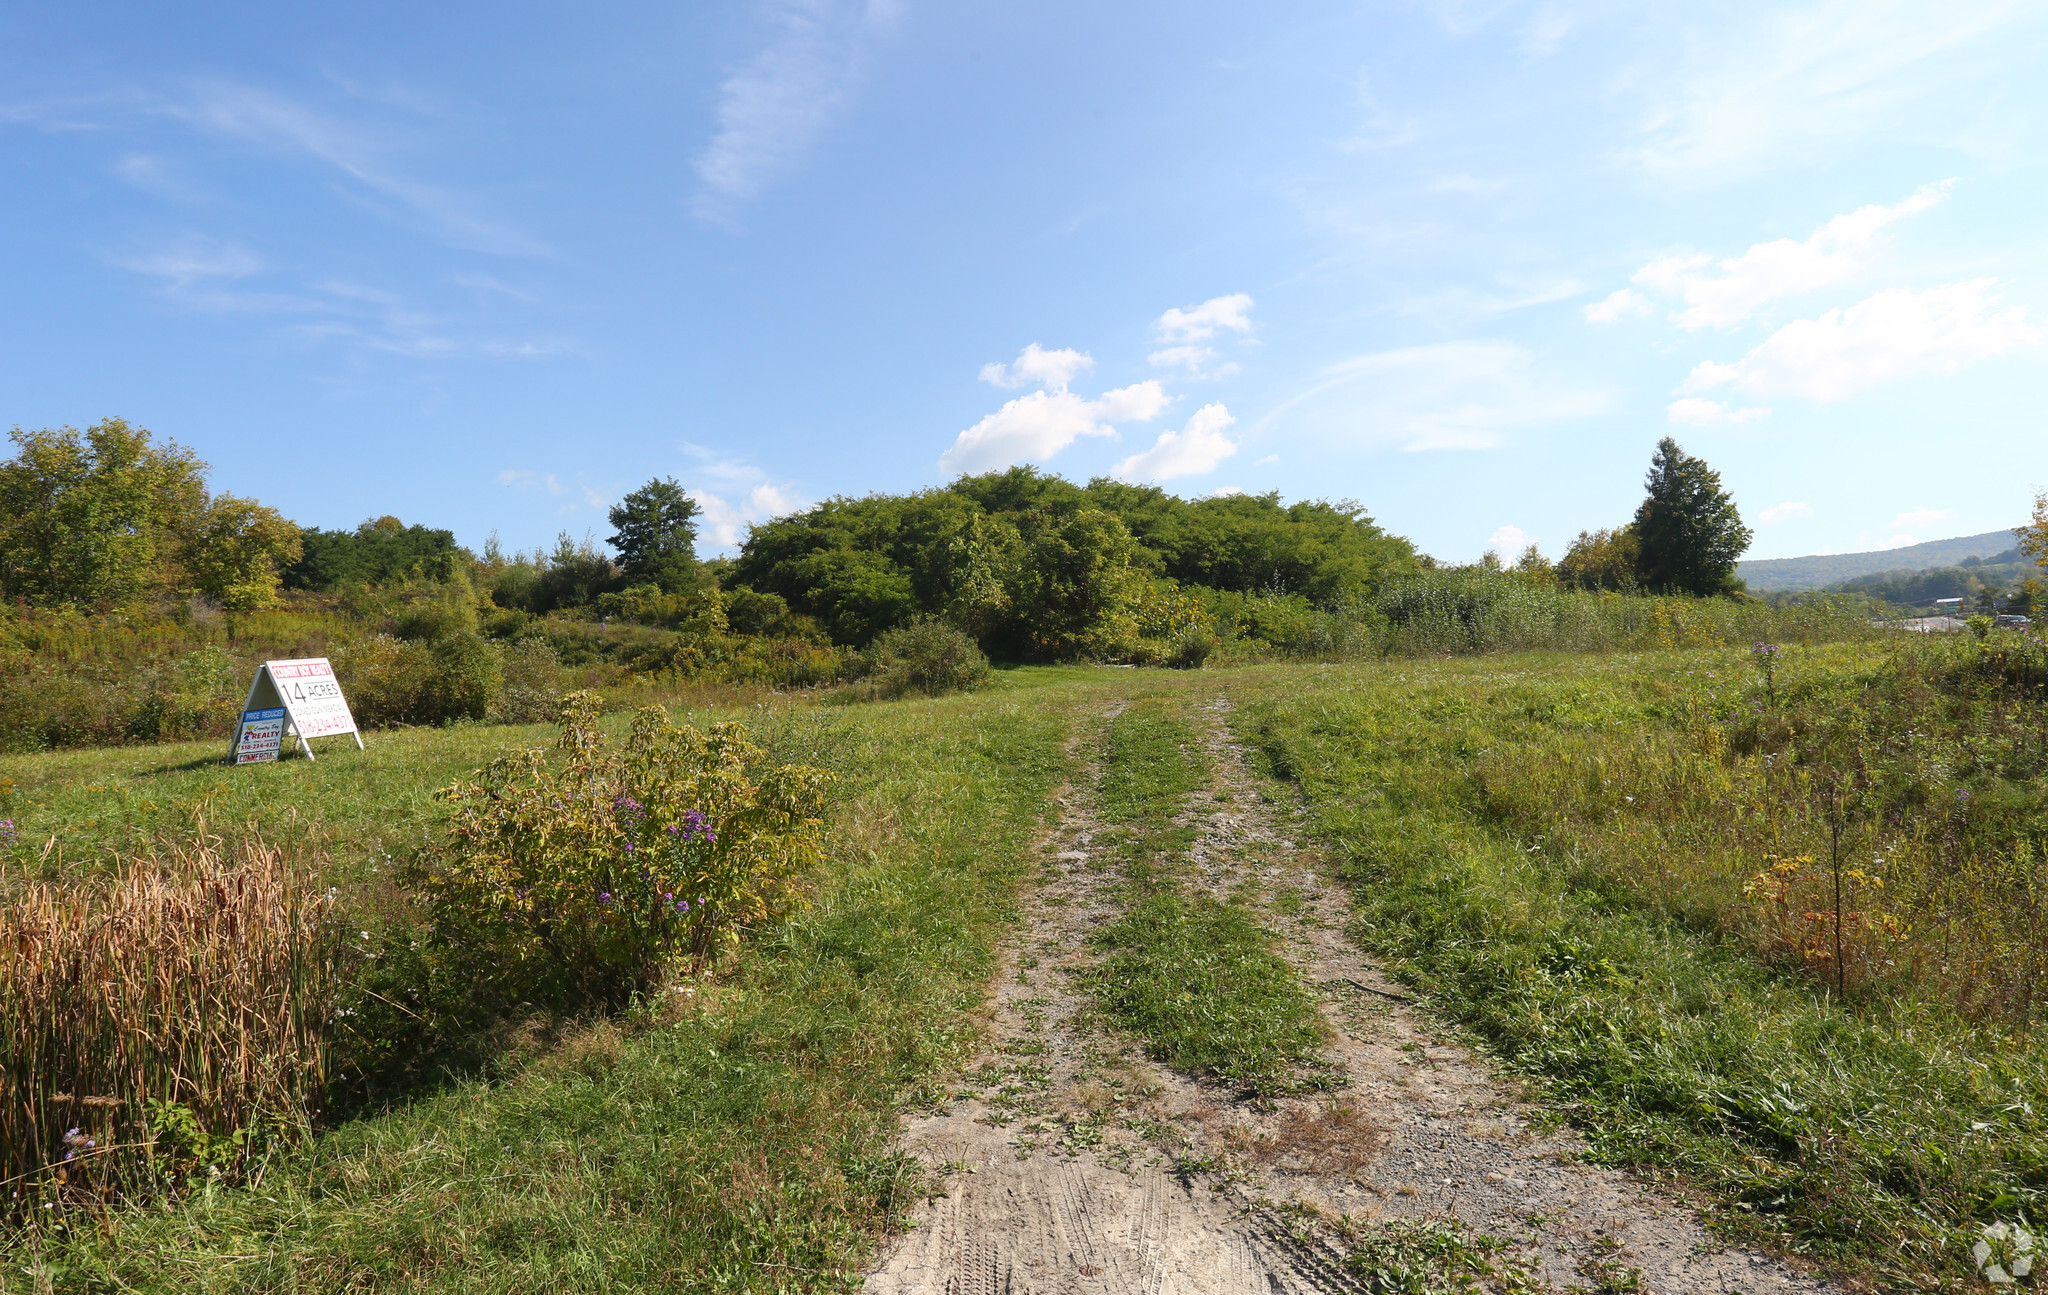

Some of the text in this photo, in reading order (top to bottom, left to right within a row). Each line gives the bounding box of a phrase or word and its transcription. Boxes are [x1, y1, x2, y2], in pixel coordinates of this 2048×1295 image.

[282, 682, 338, 704] 14 ACRES
[246, 709, 284, 721] PRICE REDUCED
[298, 715, 353, 734] 518-234-4371
[252, 730, 280, 739] REALTY
[241, 742, 278, 750] 518-234-4371
